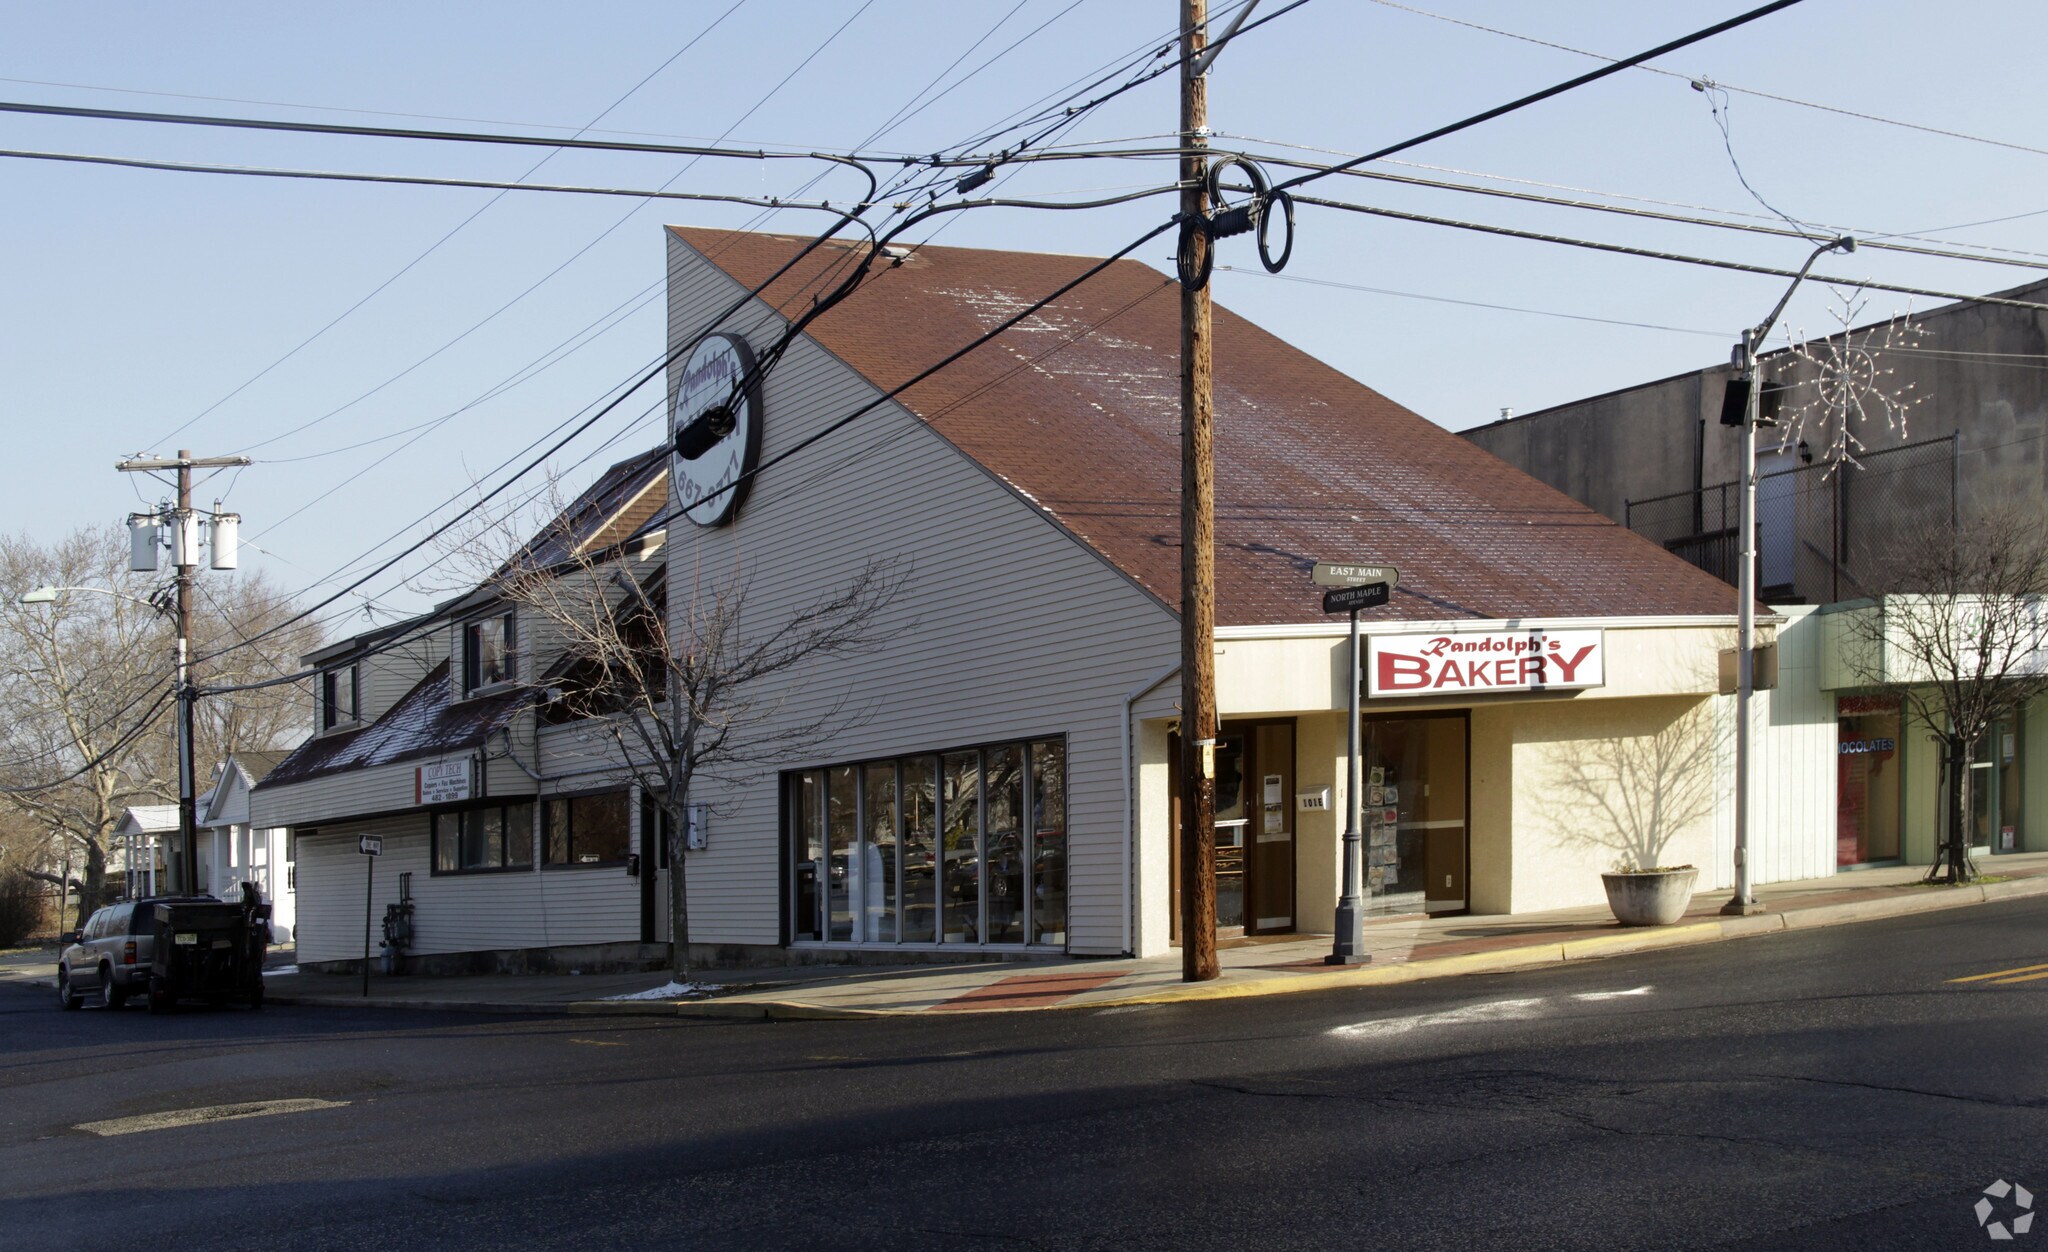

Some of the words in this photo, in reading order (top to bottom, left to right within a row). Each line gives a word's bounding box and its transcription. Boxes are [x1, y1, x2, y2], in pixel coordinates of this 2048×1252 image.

[680, 350, 736, 410] Randolph's
[1330, 566, 1355, 576] EAST
[1357, 567, 1383, 577] MAIN
[1330, 590, 1355, 603] NORTH
[1357, 587, 1382, 598] MAPLE
[1420, 635, 1561, 658] Randolph's
[1378, 644, 1598, 690] BAKERY
[428, 765, 443, 778] COPY
[445, 762, 462, 775] TECH
[1304, 798, 1322, 808] 101E
